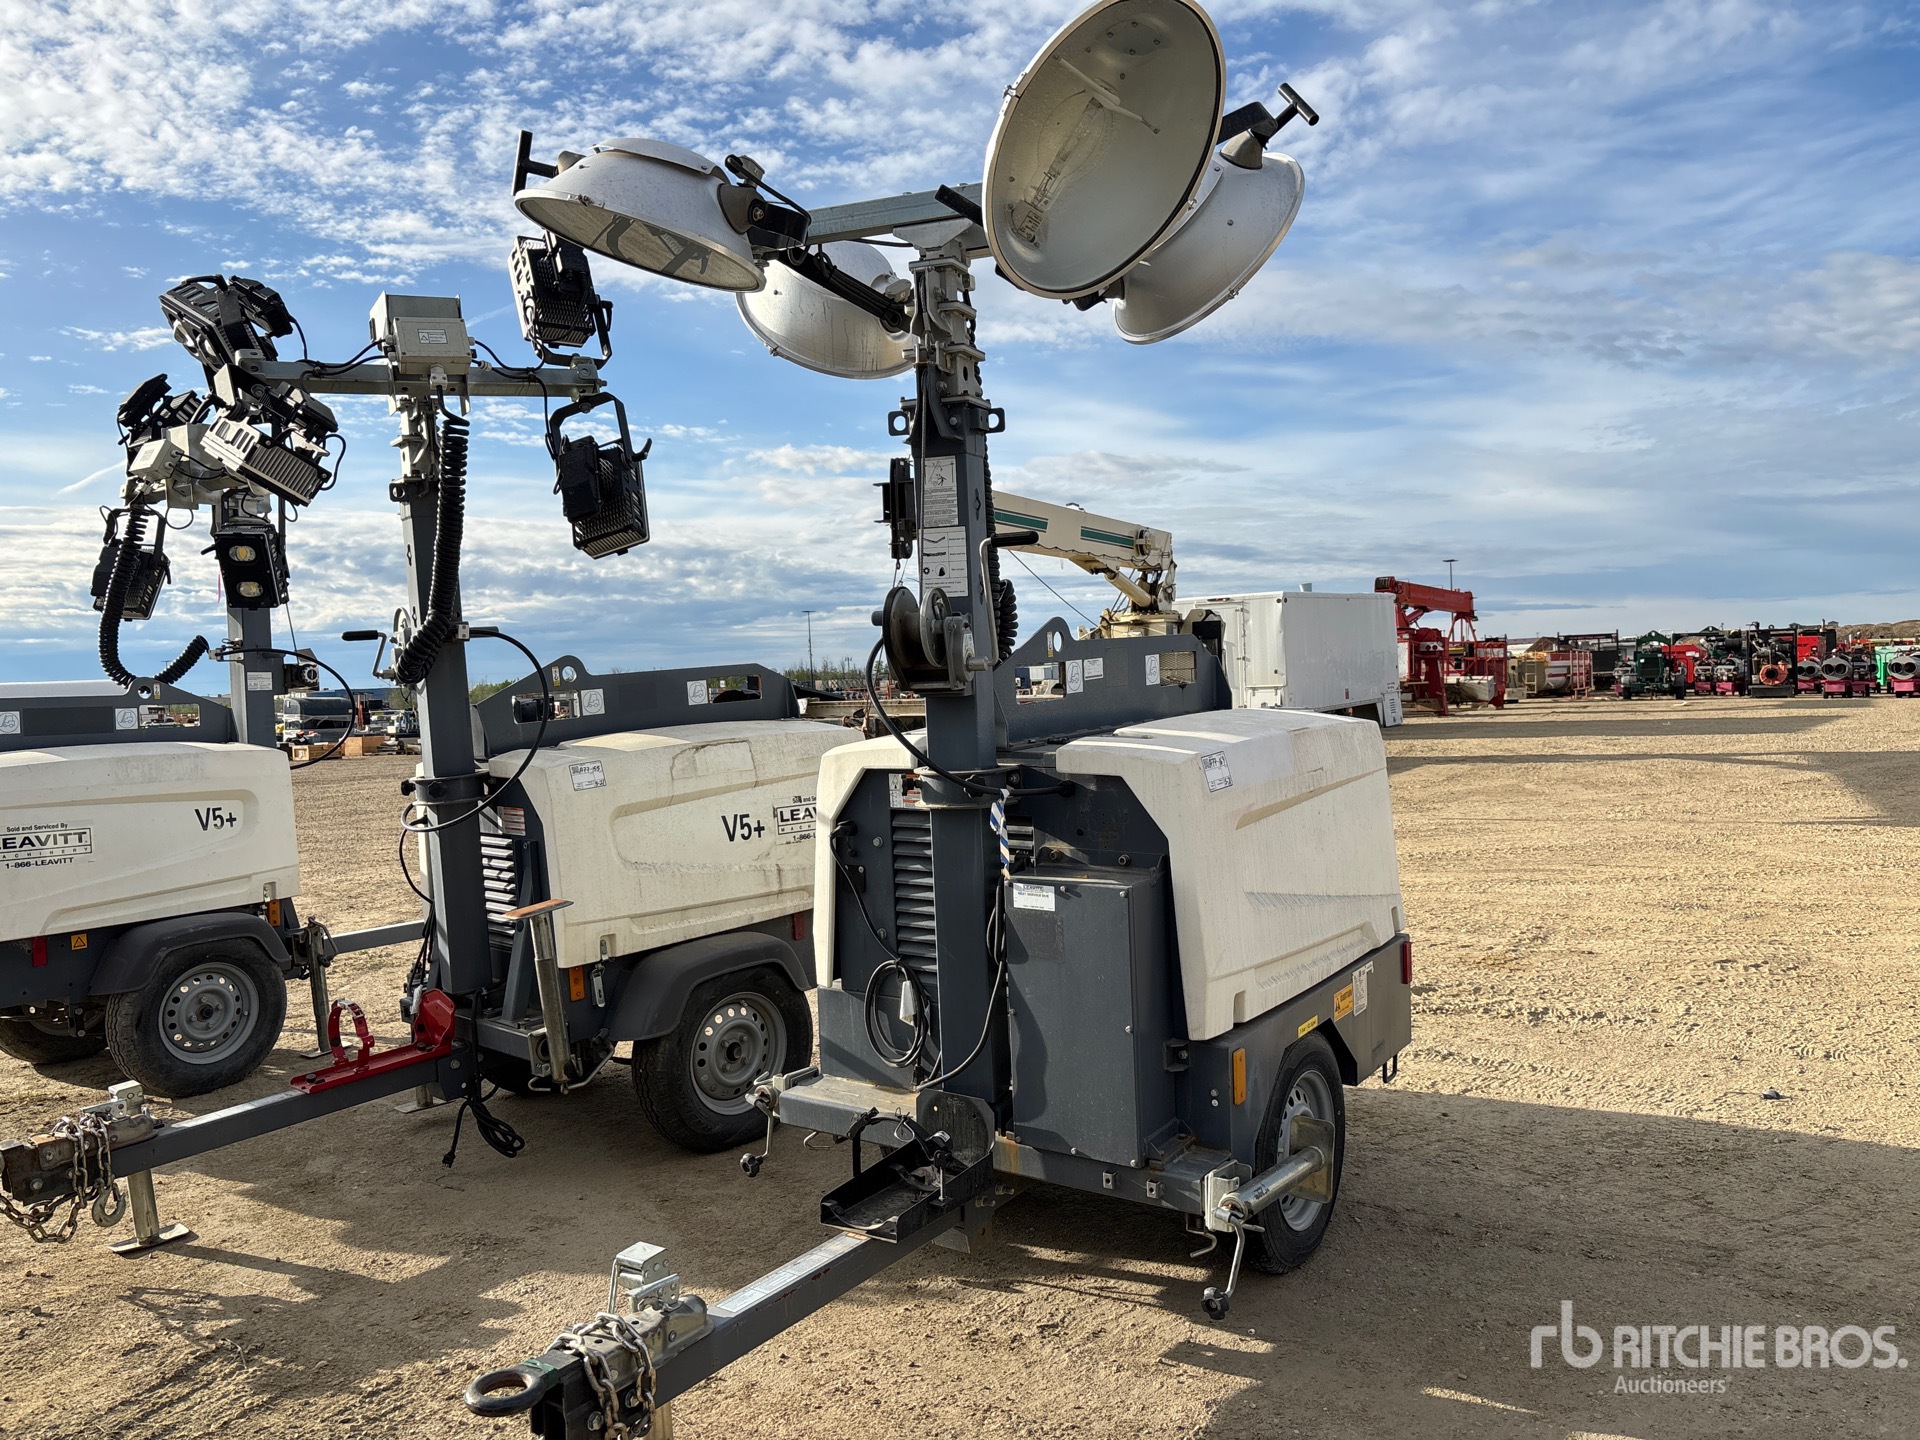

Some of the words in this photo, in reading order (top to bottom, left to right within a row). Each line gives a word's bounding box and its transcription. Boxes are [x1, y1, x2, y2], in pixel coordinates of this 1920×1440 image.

[60, 822, 68, 830] By
[194, 807, 237, 832] V5+
[721, 813, 765, 842] V5+
[0, 831, 87, 850] EAVITT
[2, 848, 88, 859] ACHINERY
[5, 857, 75, 869] 1-866-LEAVITT
